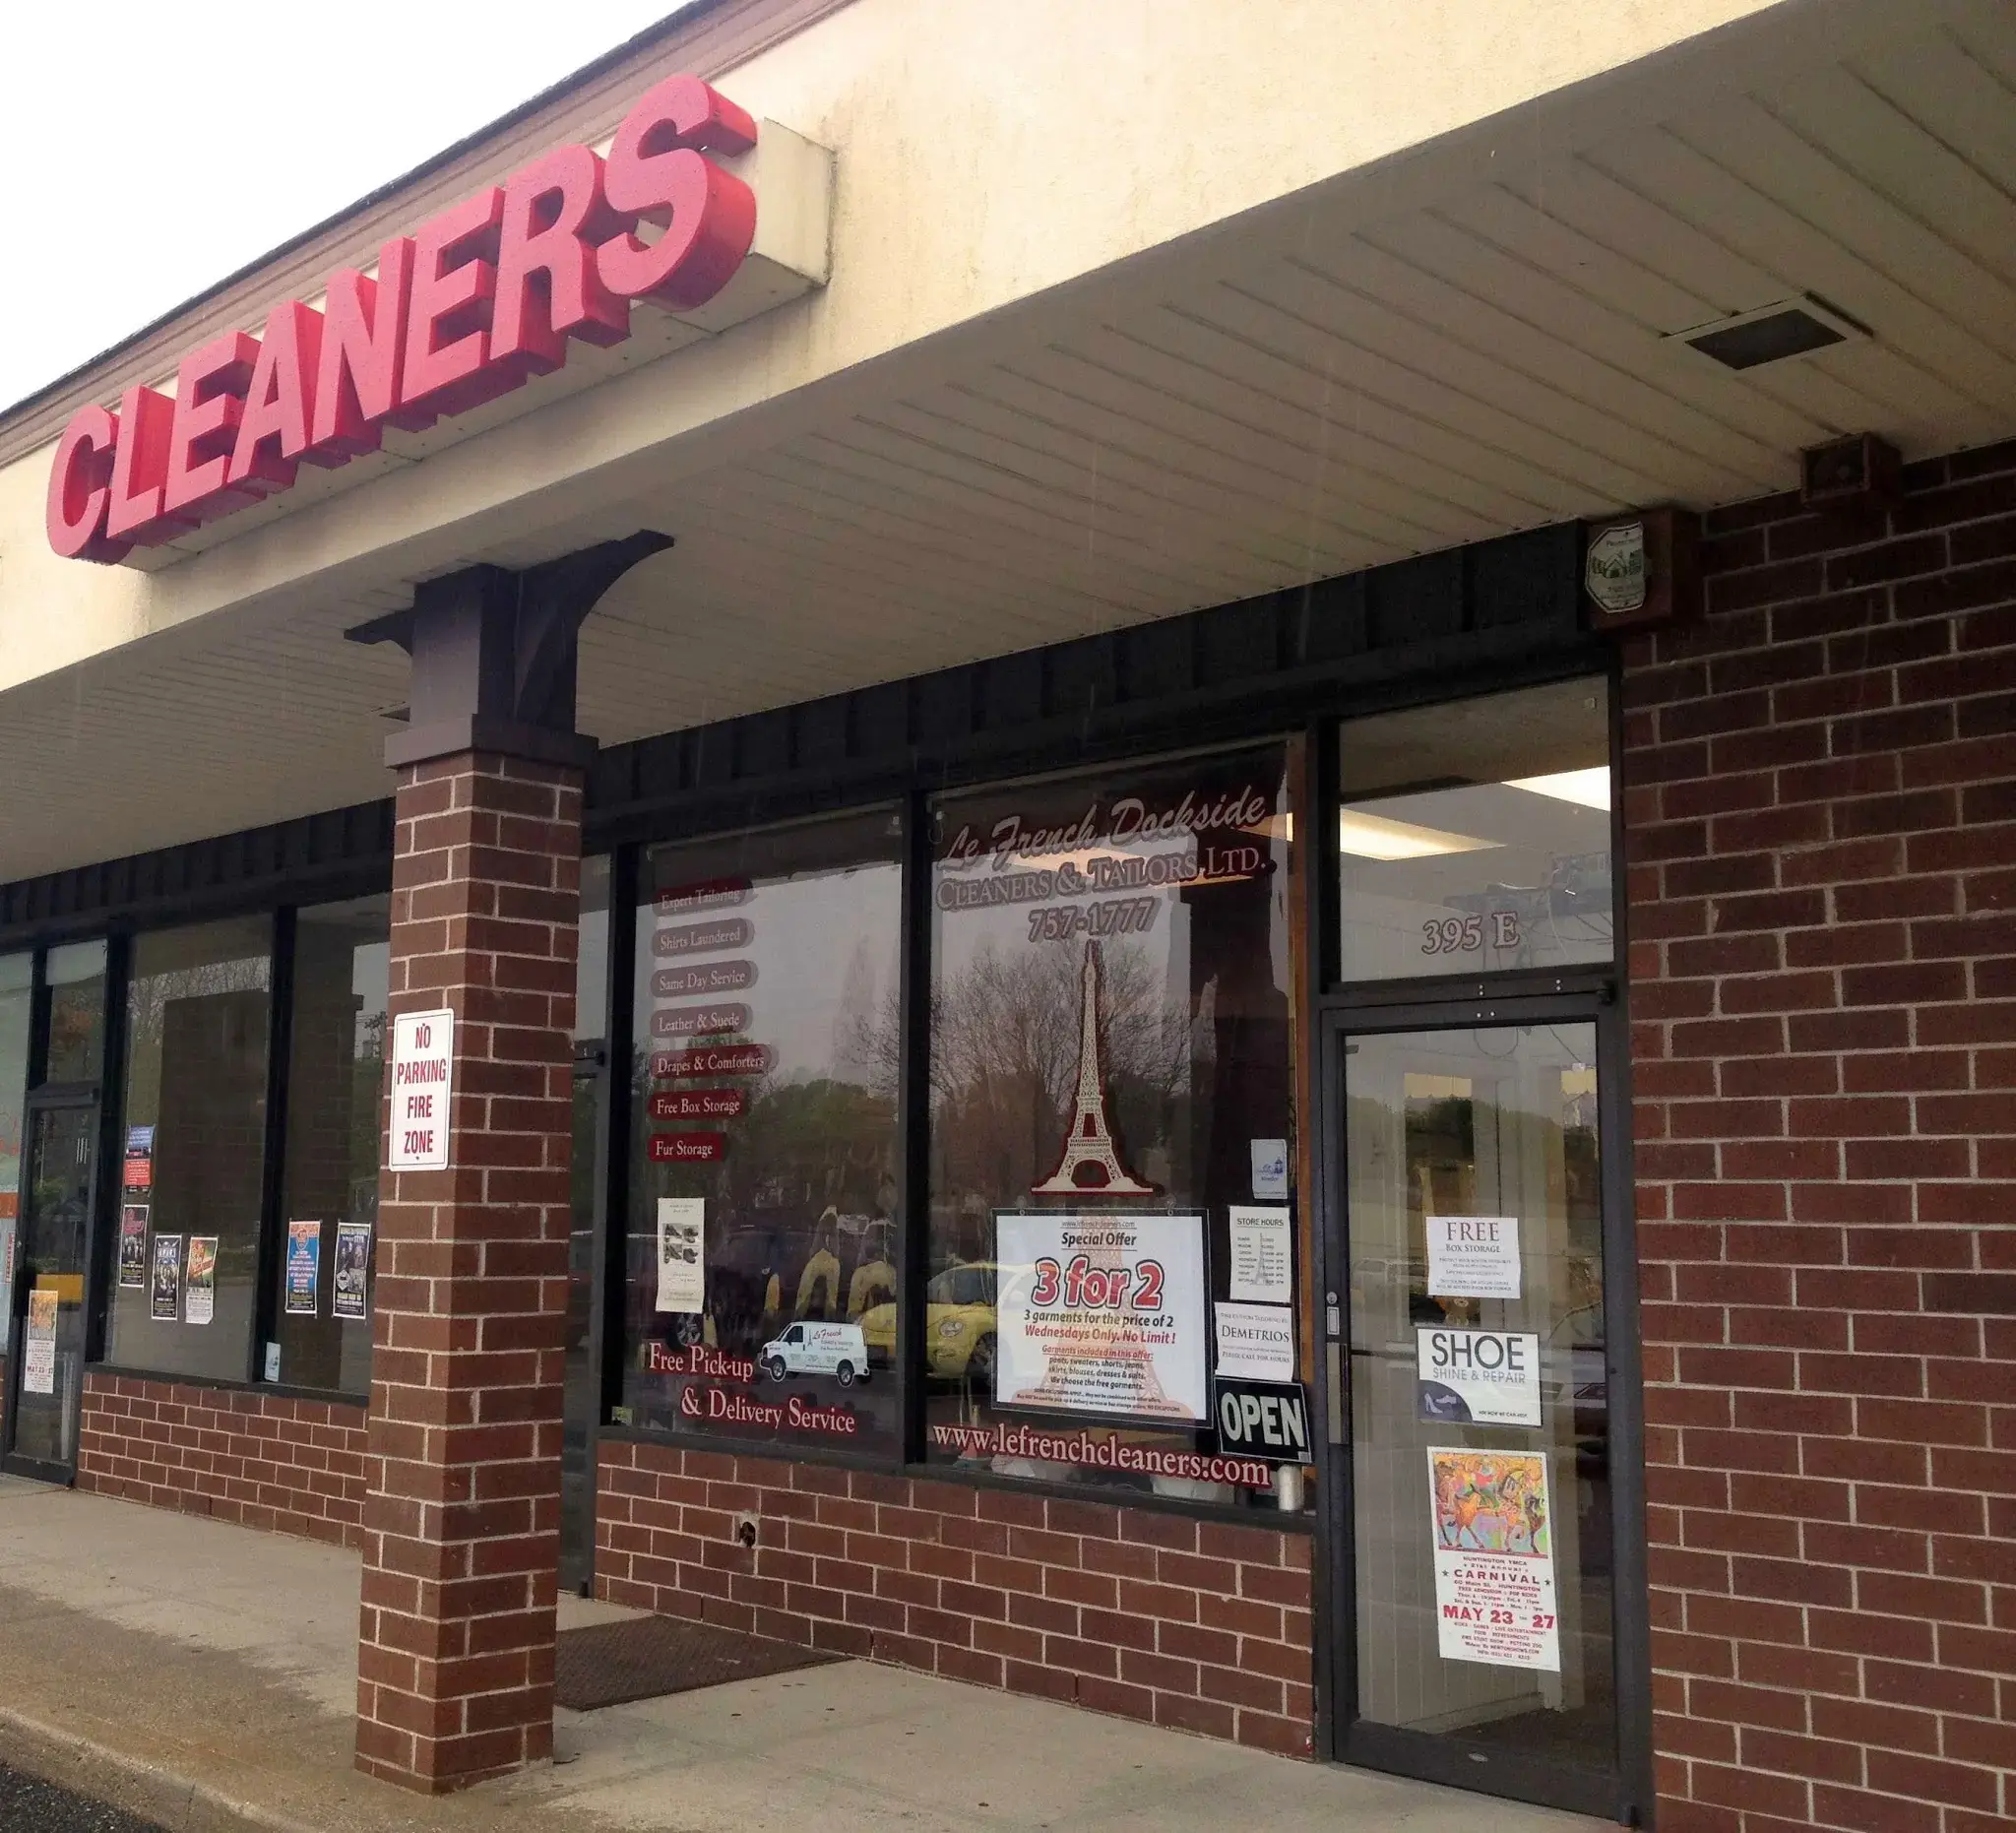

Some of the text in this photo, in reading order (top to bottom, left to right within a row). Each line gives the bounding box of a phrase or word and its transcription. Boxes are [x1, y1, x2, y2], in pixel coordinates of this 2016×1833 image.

[45, 73, 756, 565] CLEANERS
[937, 785, 1267, 871] Le French Dockside
[935, 870, 1053, 912] CLEANERS
[1055, 861, 1086, 897] &
[1206, 844, 1268, 876] LTD.
[661, 886, 741, 912] Expert Tailoring
[1028, 896, 1160, 944] 757-1777
[661, 926, 741, 950] Shirts Laundered
[1420, 911, 1521, 955] 395 E
[660, 969, 746, 991] Same Day Service
[659, 1012, 740, 1032] Leather & Suede
[415, 1025, 431, 1049] NO
[397, 1058, 447, 1085] PARKING
[658, 1053, 765, 1076] Drapes & Comforters
[408, 1094, 433, 1119] FIRE
[657, 1097, 740, 1115] Free Box Storage
[404, 1130, 433, 1154] ZONE
[656, 1140, 713, 1159] Fur Storage
[1236, 1218, 1285, 1228] STORE HOURS
[1446, 1222, 1500, 1242] FREE
[1061, 1232, 1137, 1247] Special Offer
[1445, 1243, 1501, 1254] BOX STORAGE
[1031, 1254, 1165, 1311] 3 for 2
[1024, 1309, 1174, 1329] 3 garments for the price of 2
[1025, 1325, 1090, 1341] Wednesdays
[1092, 1328, 1120, 1343] Only.
[1122, 1330, 1138, 1343] No
[1222, 1324, 1290, 1343] DEMETRIOS
[649, 1342, 754, 1383] Free Pick-up
[1042, 1345, 1076, 1355] Garments
[1077, 1347, 1109, 1357] included
[1117, 1350, 1131, 1359] this
[1132, 1350, 1154, 1359] offer:
[1070, 1359, 1101, 1367] sweaters,
[1431, 1332, 1525, 1371] SHOE
[1061, 1377, 1084, 1386] choose
[1097, 1369, 1120, 1378] dresses
[1432, 1366, 1526, 1385] SHINE & REPAIR
[680, 1386, 855, 1433] & Delivery Service
[1221, 1392, 1305, 1448] OPEN
[932, 1423, 1270, 1485] www.lefrenchcleaners.com
[1454, 1569, 1541, 1585] CARNIVAL
[1443, 1605, 1483, 1621] MAY
[1490, 1610, 1513, 1625] 23
[1532, 1614, 1554, 1629] 27
